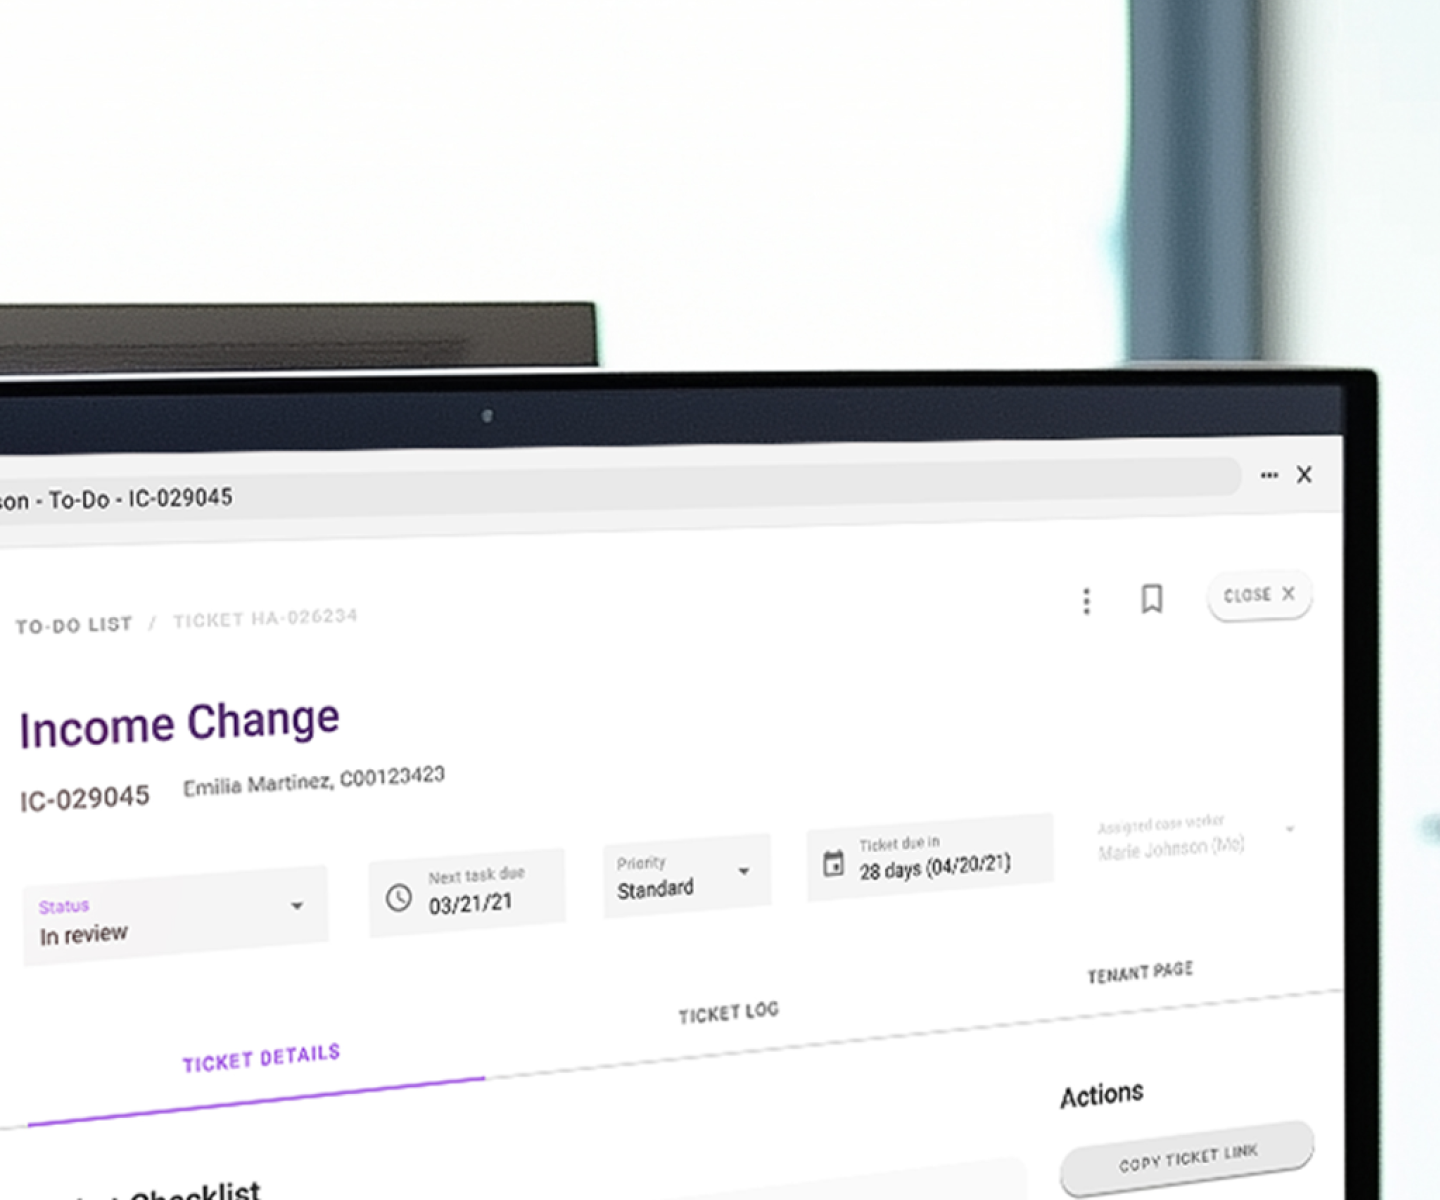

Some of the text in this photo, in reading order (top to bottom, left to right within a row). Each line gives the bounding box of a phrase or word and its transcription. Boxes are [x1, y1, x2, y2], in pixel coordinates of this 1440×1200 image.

[48, 489, 111, 510] To-Do
[128, 486, 233, 508] IC-029045
[1223, 585, 1272, 604] CLOSE
[15, 616, 81, 635] TO-DO
[88, 615, 133, 633] LIST
[172, 611, 244, 629] TICKET
[251, 607, 358, 626] HA-026234
[20, 701, 340, 750] Income Change
[182, 764, 446, 798] Emilia Martinez, C00123423
[20, 784, 150, 813] IC-029045
[859, 835, 941, 853] Ticket due in
[428, 865, 526, 885] Next task due
[616, 856, 667, 872] Priority
[859, 851, 1012, 883] 28 days (04/20/21)
[617, 876, 695, 901] Standard
[38, 899, 91, 916] Status
[428, 891, 512, 916] 03/21/21
[40, 923, 129, 947] In review
[1087, 959, 1194, 985] TENANT PAGE
[678, 1000, 780, 1025] TICKET LOG
[182, 1042, 341, 1074] TICKET DETAILS
[1060, 1082, 1145, 1110] Actions
[1118, 1143, 1259, 1174] COPY TICKET LINK
